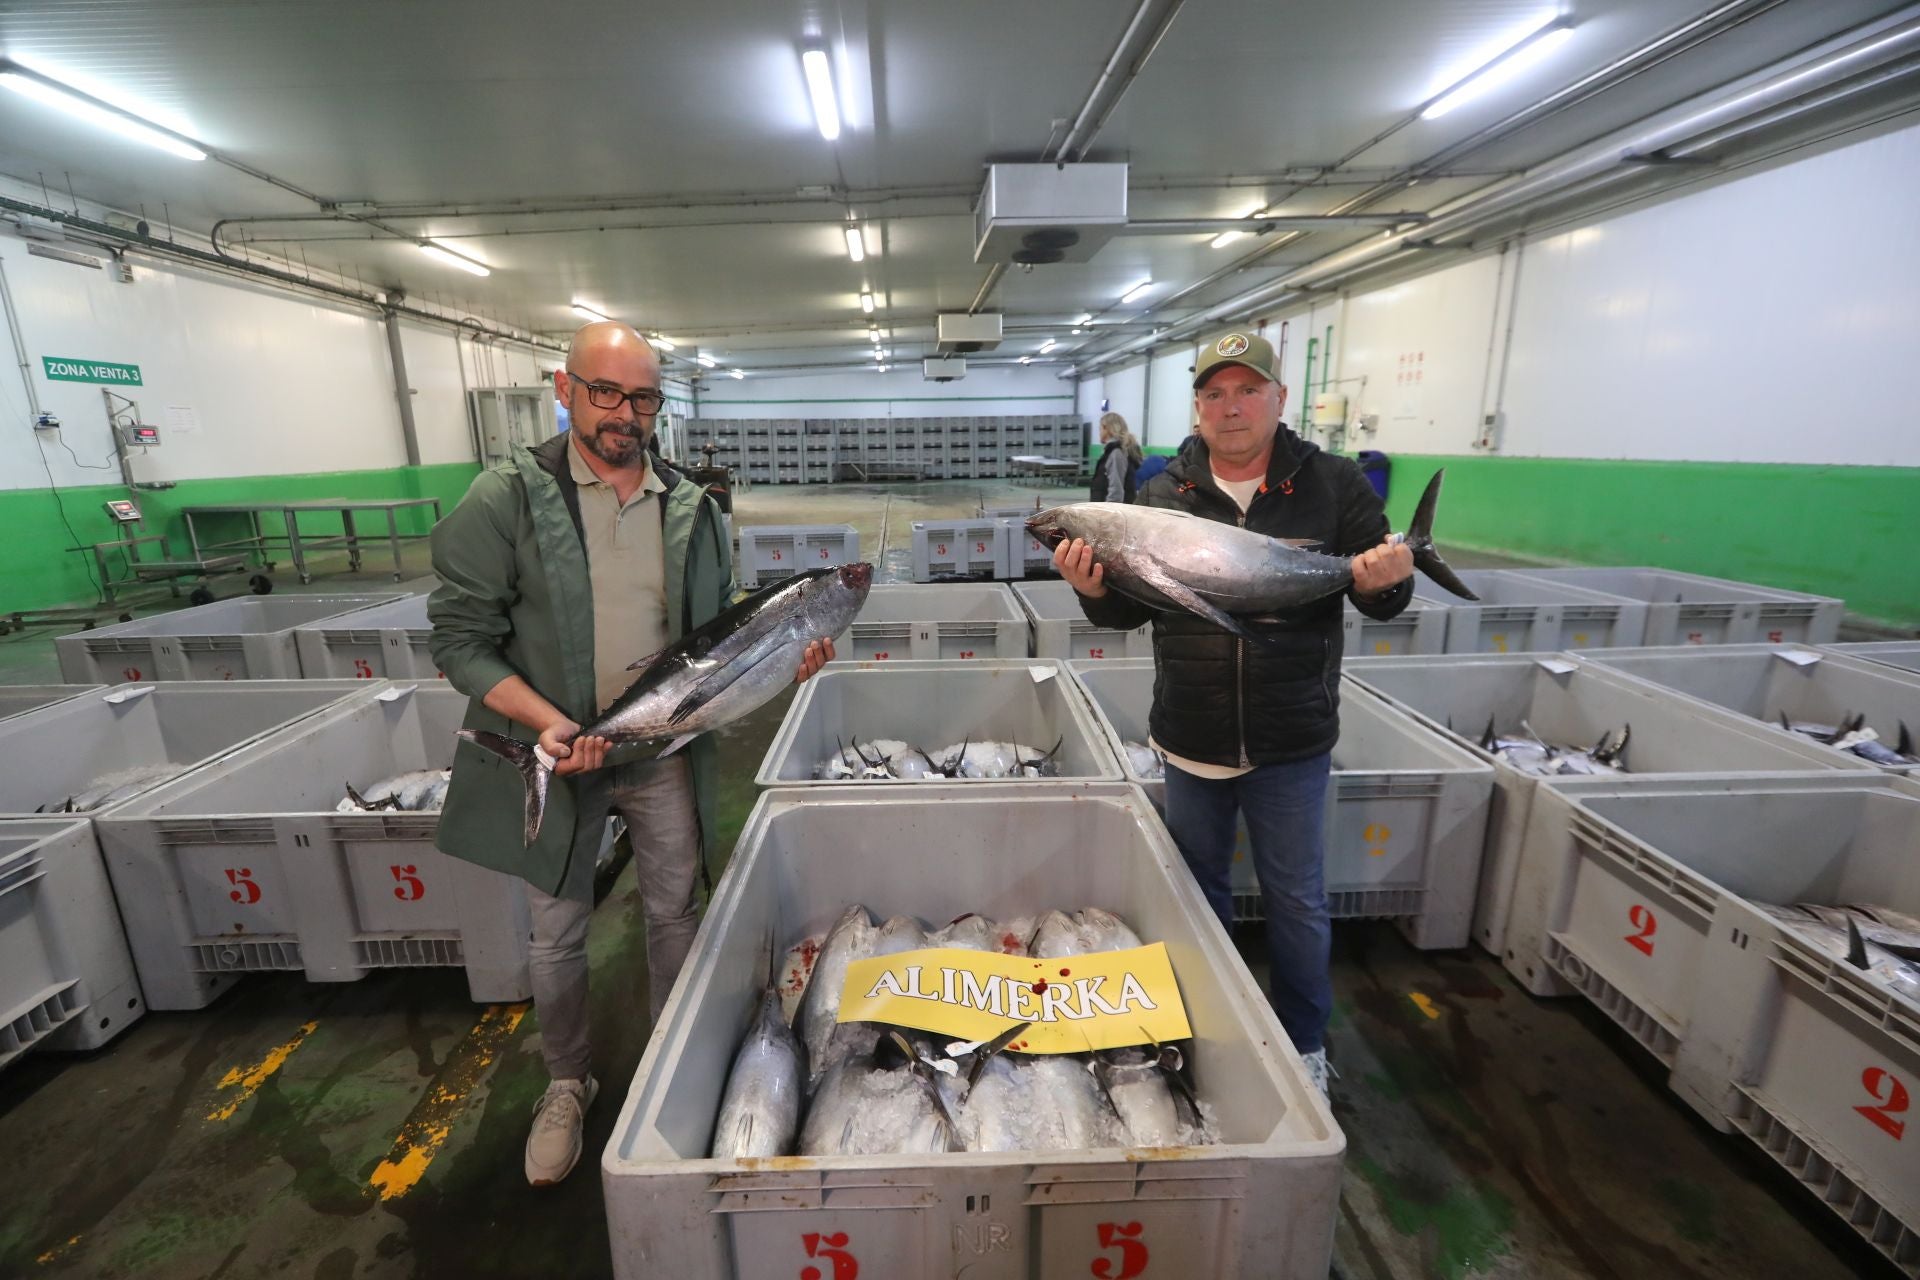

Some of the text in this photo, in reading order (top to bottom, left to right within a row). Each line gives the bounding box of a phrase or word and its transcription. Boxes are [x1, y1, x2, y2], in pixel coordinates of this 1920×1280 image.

[48, 362, 140, 382] ZONA VENTA 3
[820, 548, 829, 559] 5
[976, 542, 986, 553] 5
[355, 660, 372, 678] 5
[225, 868, 261, 904] 5
[390, 864, 425, 900] 5
[1624, 905, 1657, 957] 2
[864, 966, 1157, 1022] ALIMERKA
[1852, 1067, 1910, 1142] 2
[800, 1232, 859, 1280] 5
[1090, 1221, 1149, 1280] 5
